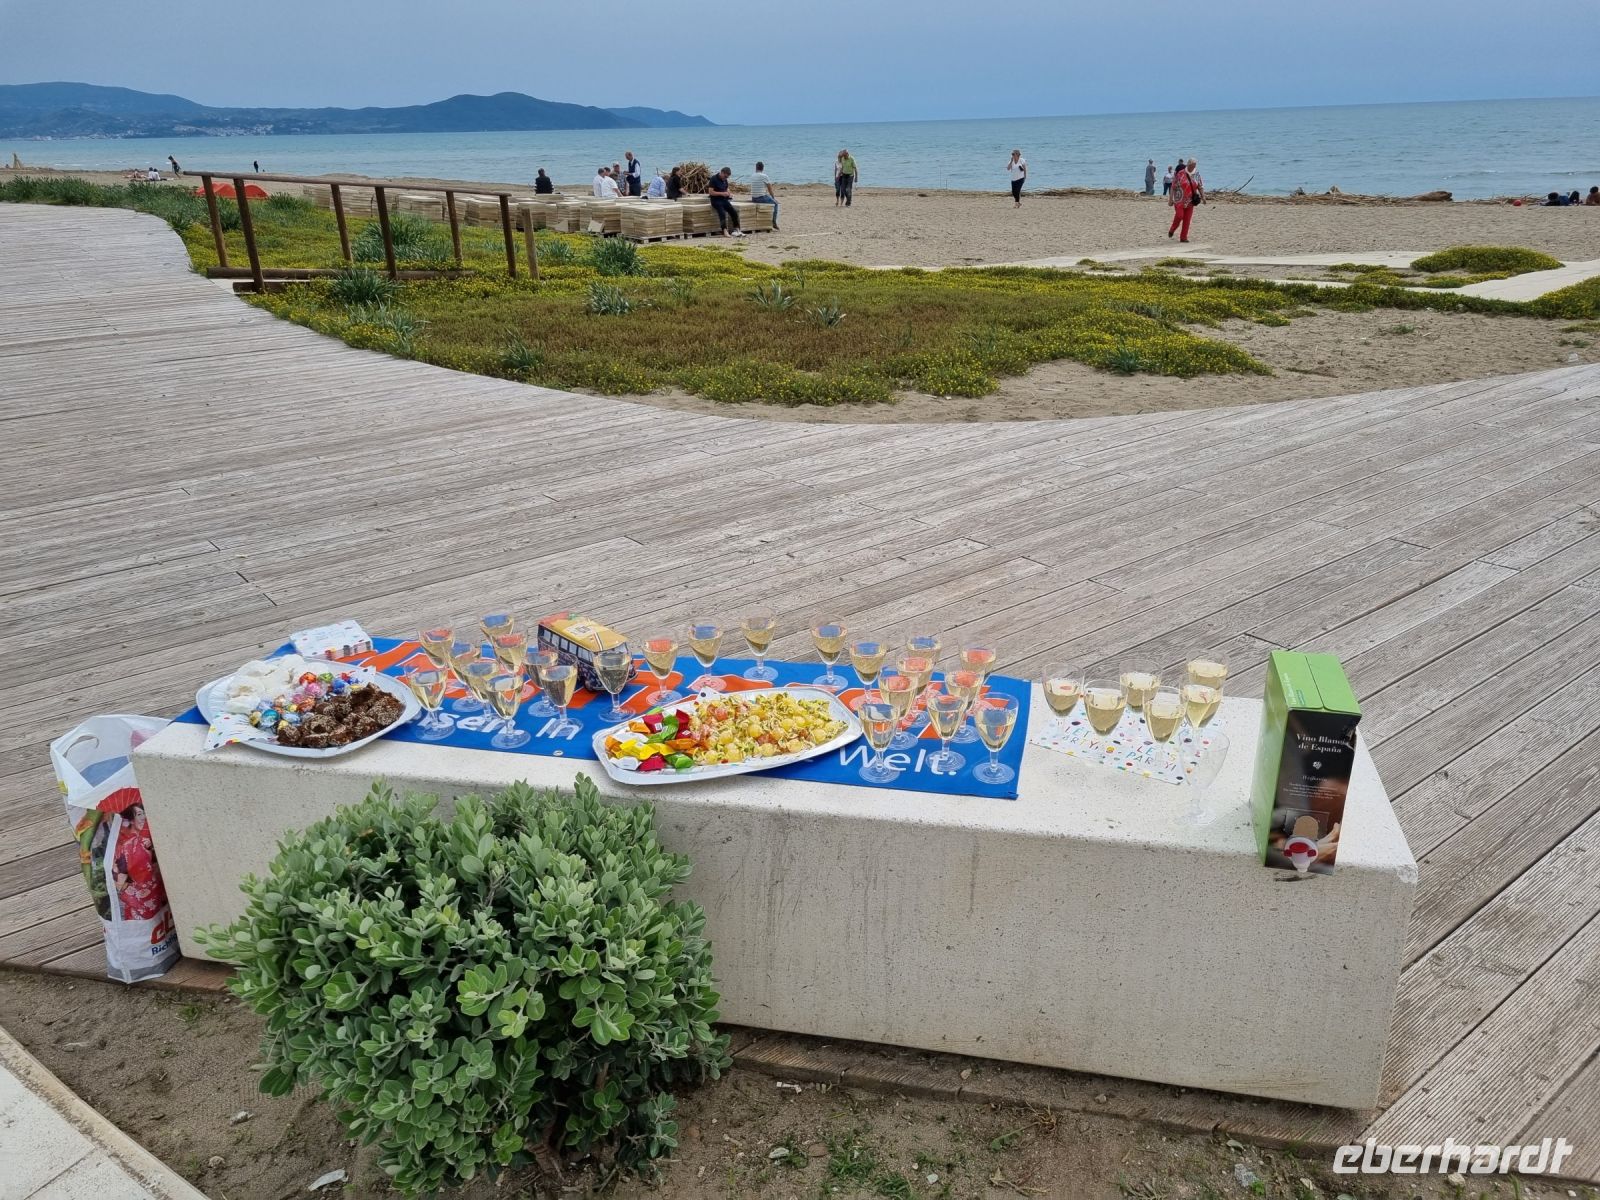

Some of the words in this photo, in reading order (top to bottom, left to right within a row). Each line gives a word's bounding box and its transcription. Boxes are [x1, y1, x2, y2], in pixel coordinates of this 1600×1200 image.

[535, 717, 580, 740] In
[1296, 733, 1316, 742] Vino
[1298, 742, 1309, 750] de
[1311, 743, 1342, 753] España
[1126, 751, 1177, 772] PARY!
